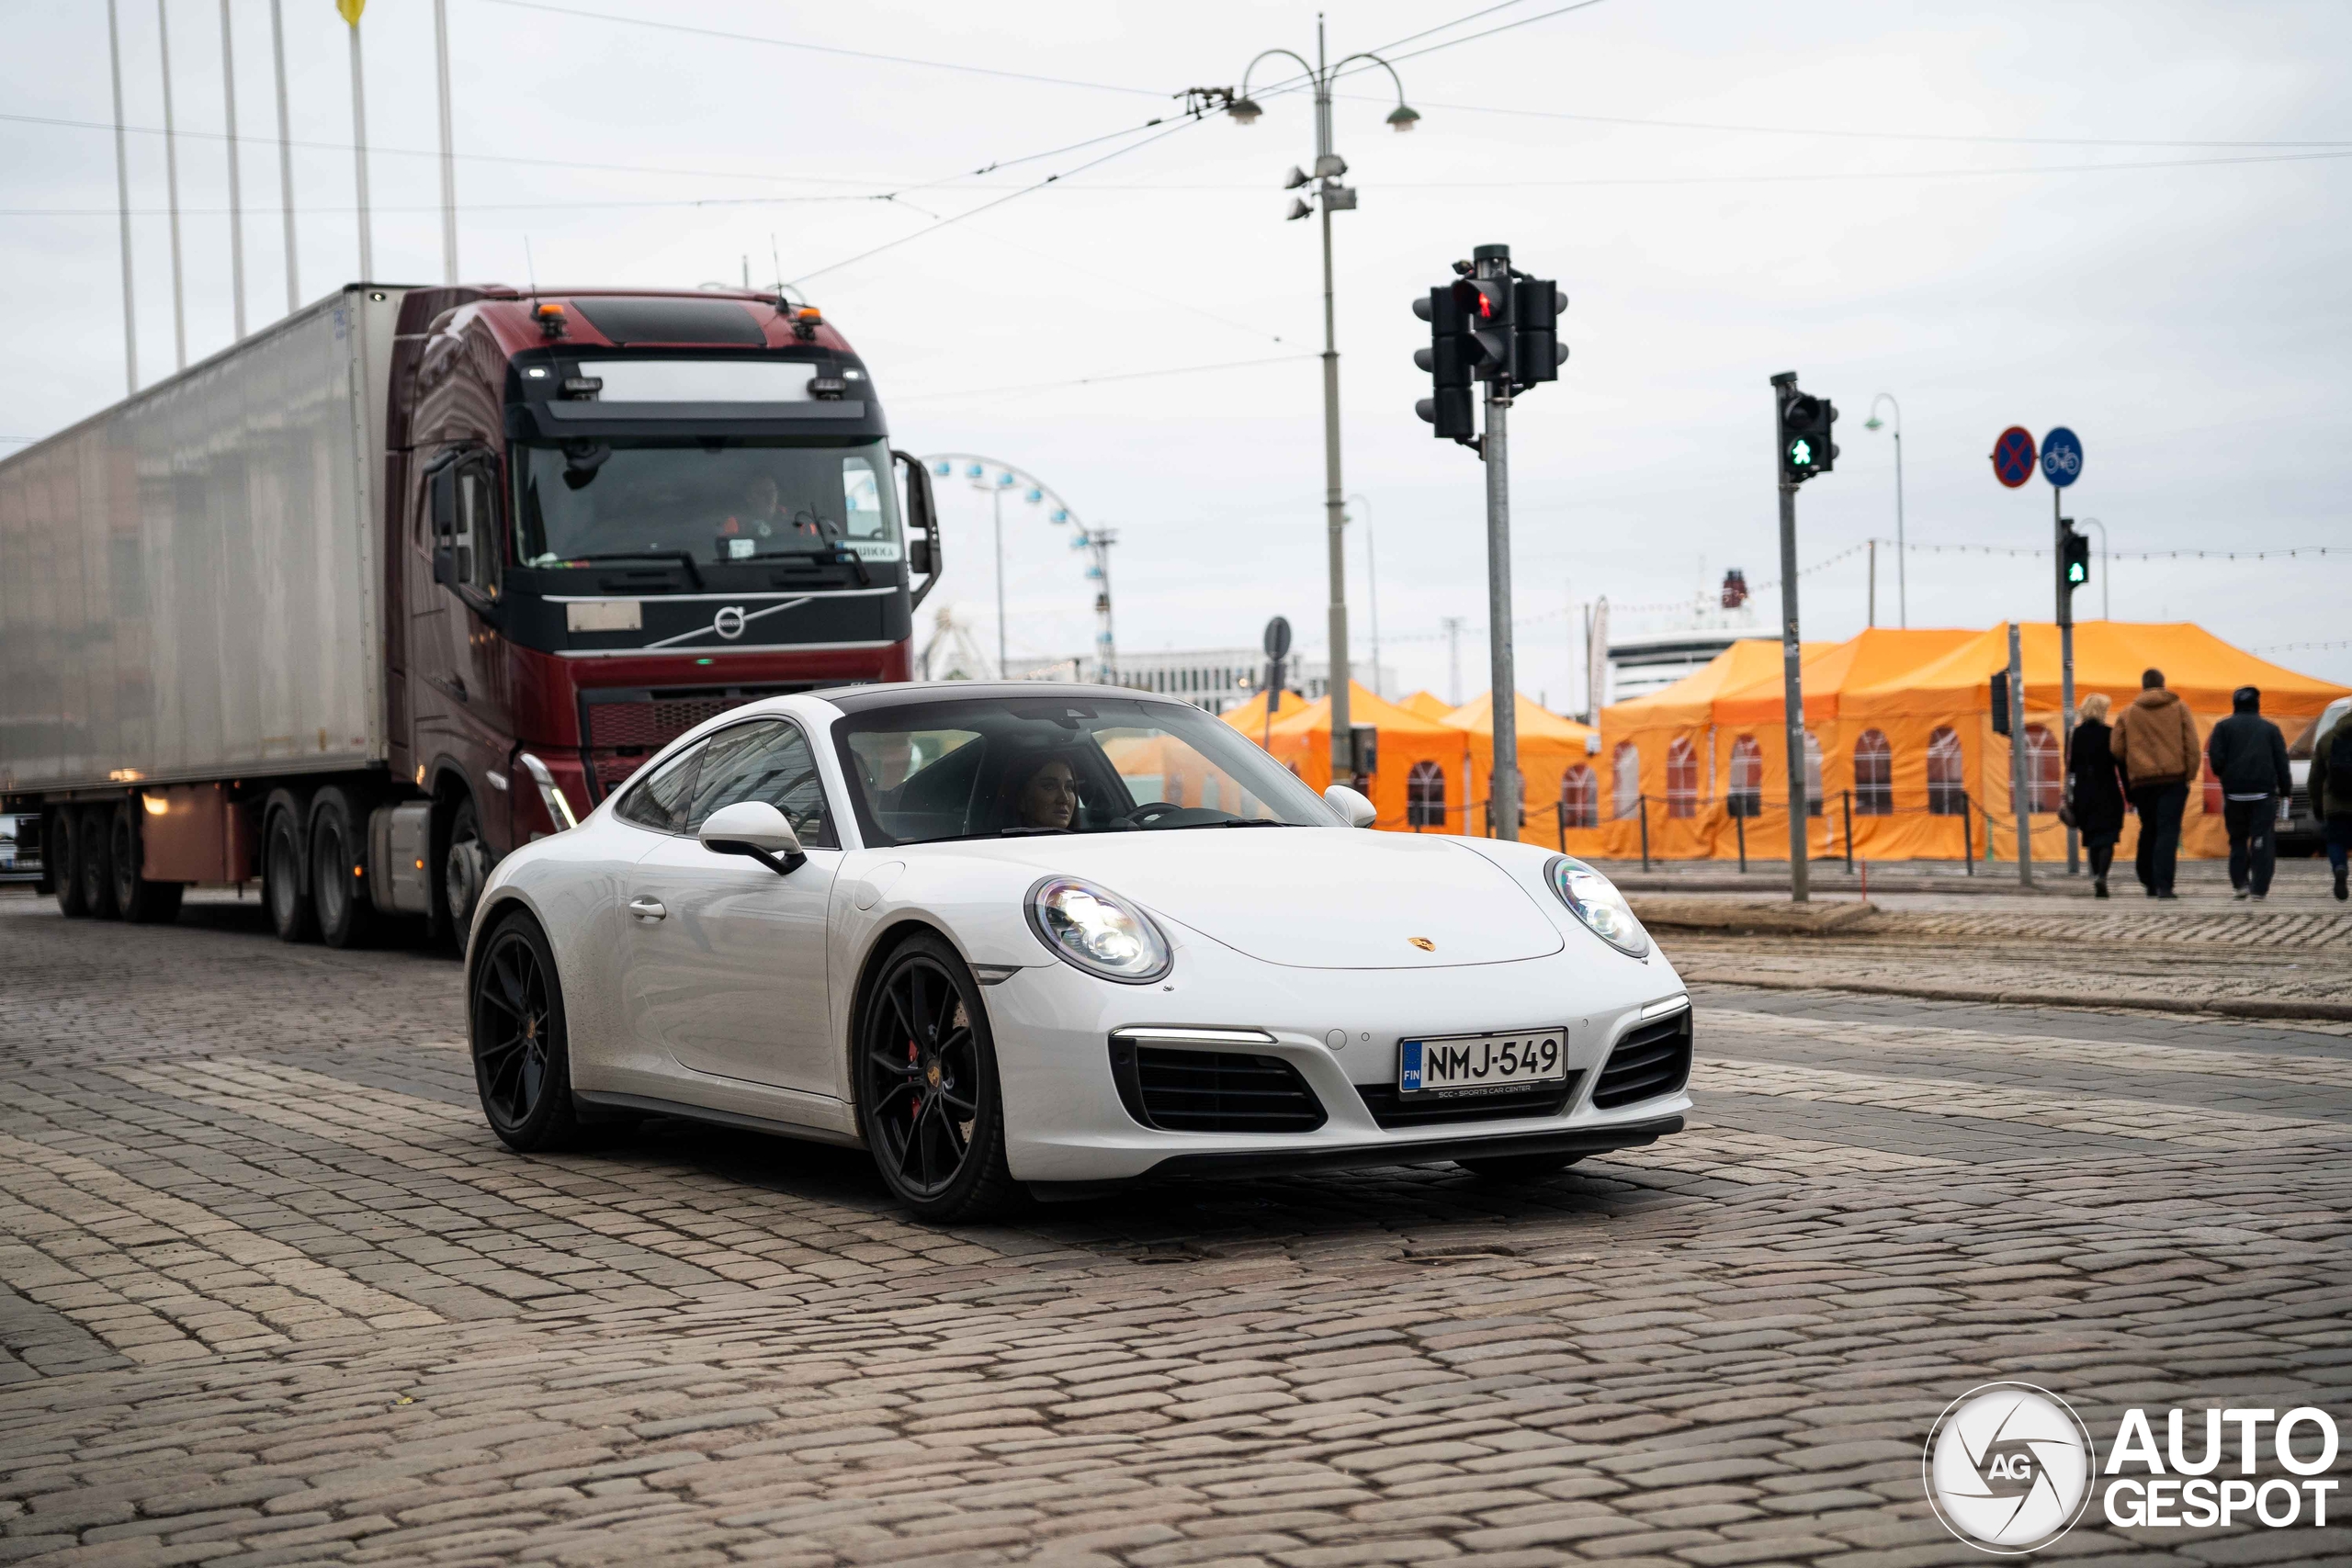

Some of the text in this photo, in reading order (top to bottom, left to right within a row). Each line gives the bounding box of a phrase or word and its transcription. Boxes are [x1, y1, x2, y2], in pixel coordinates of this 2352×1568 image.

[851, 546, 895, 558] UIKKA
[1428, 1038, 1558, 1082] NMJ-549
[1404, 1069, 1420, 1081] FIN
[1458, 1089, 1488, 1097] SPORTS
[1505, 1085, 1532, 1093] CENTER
